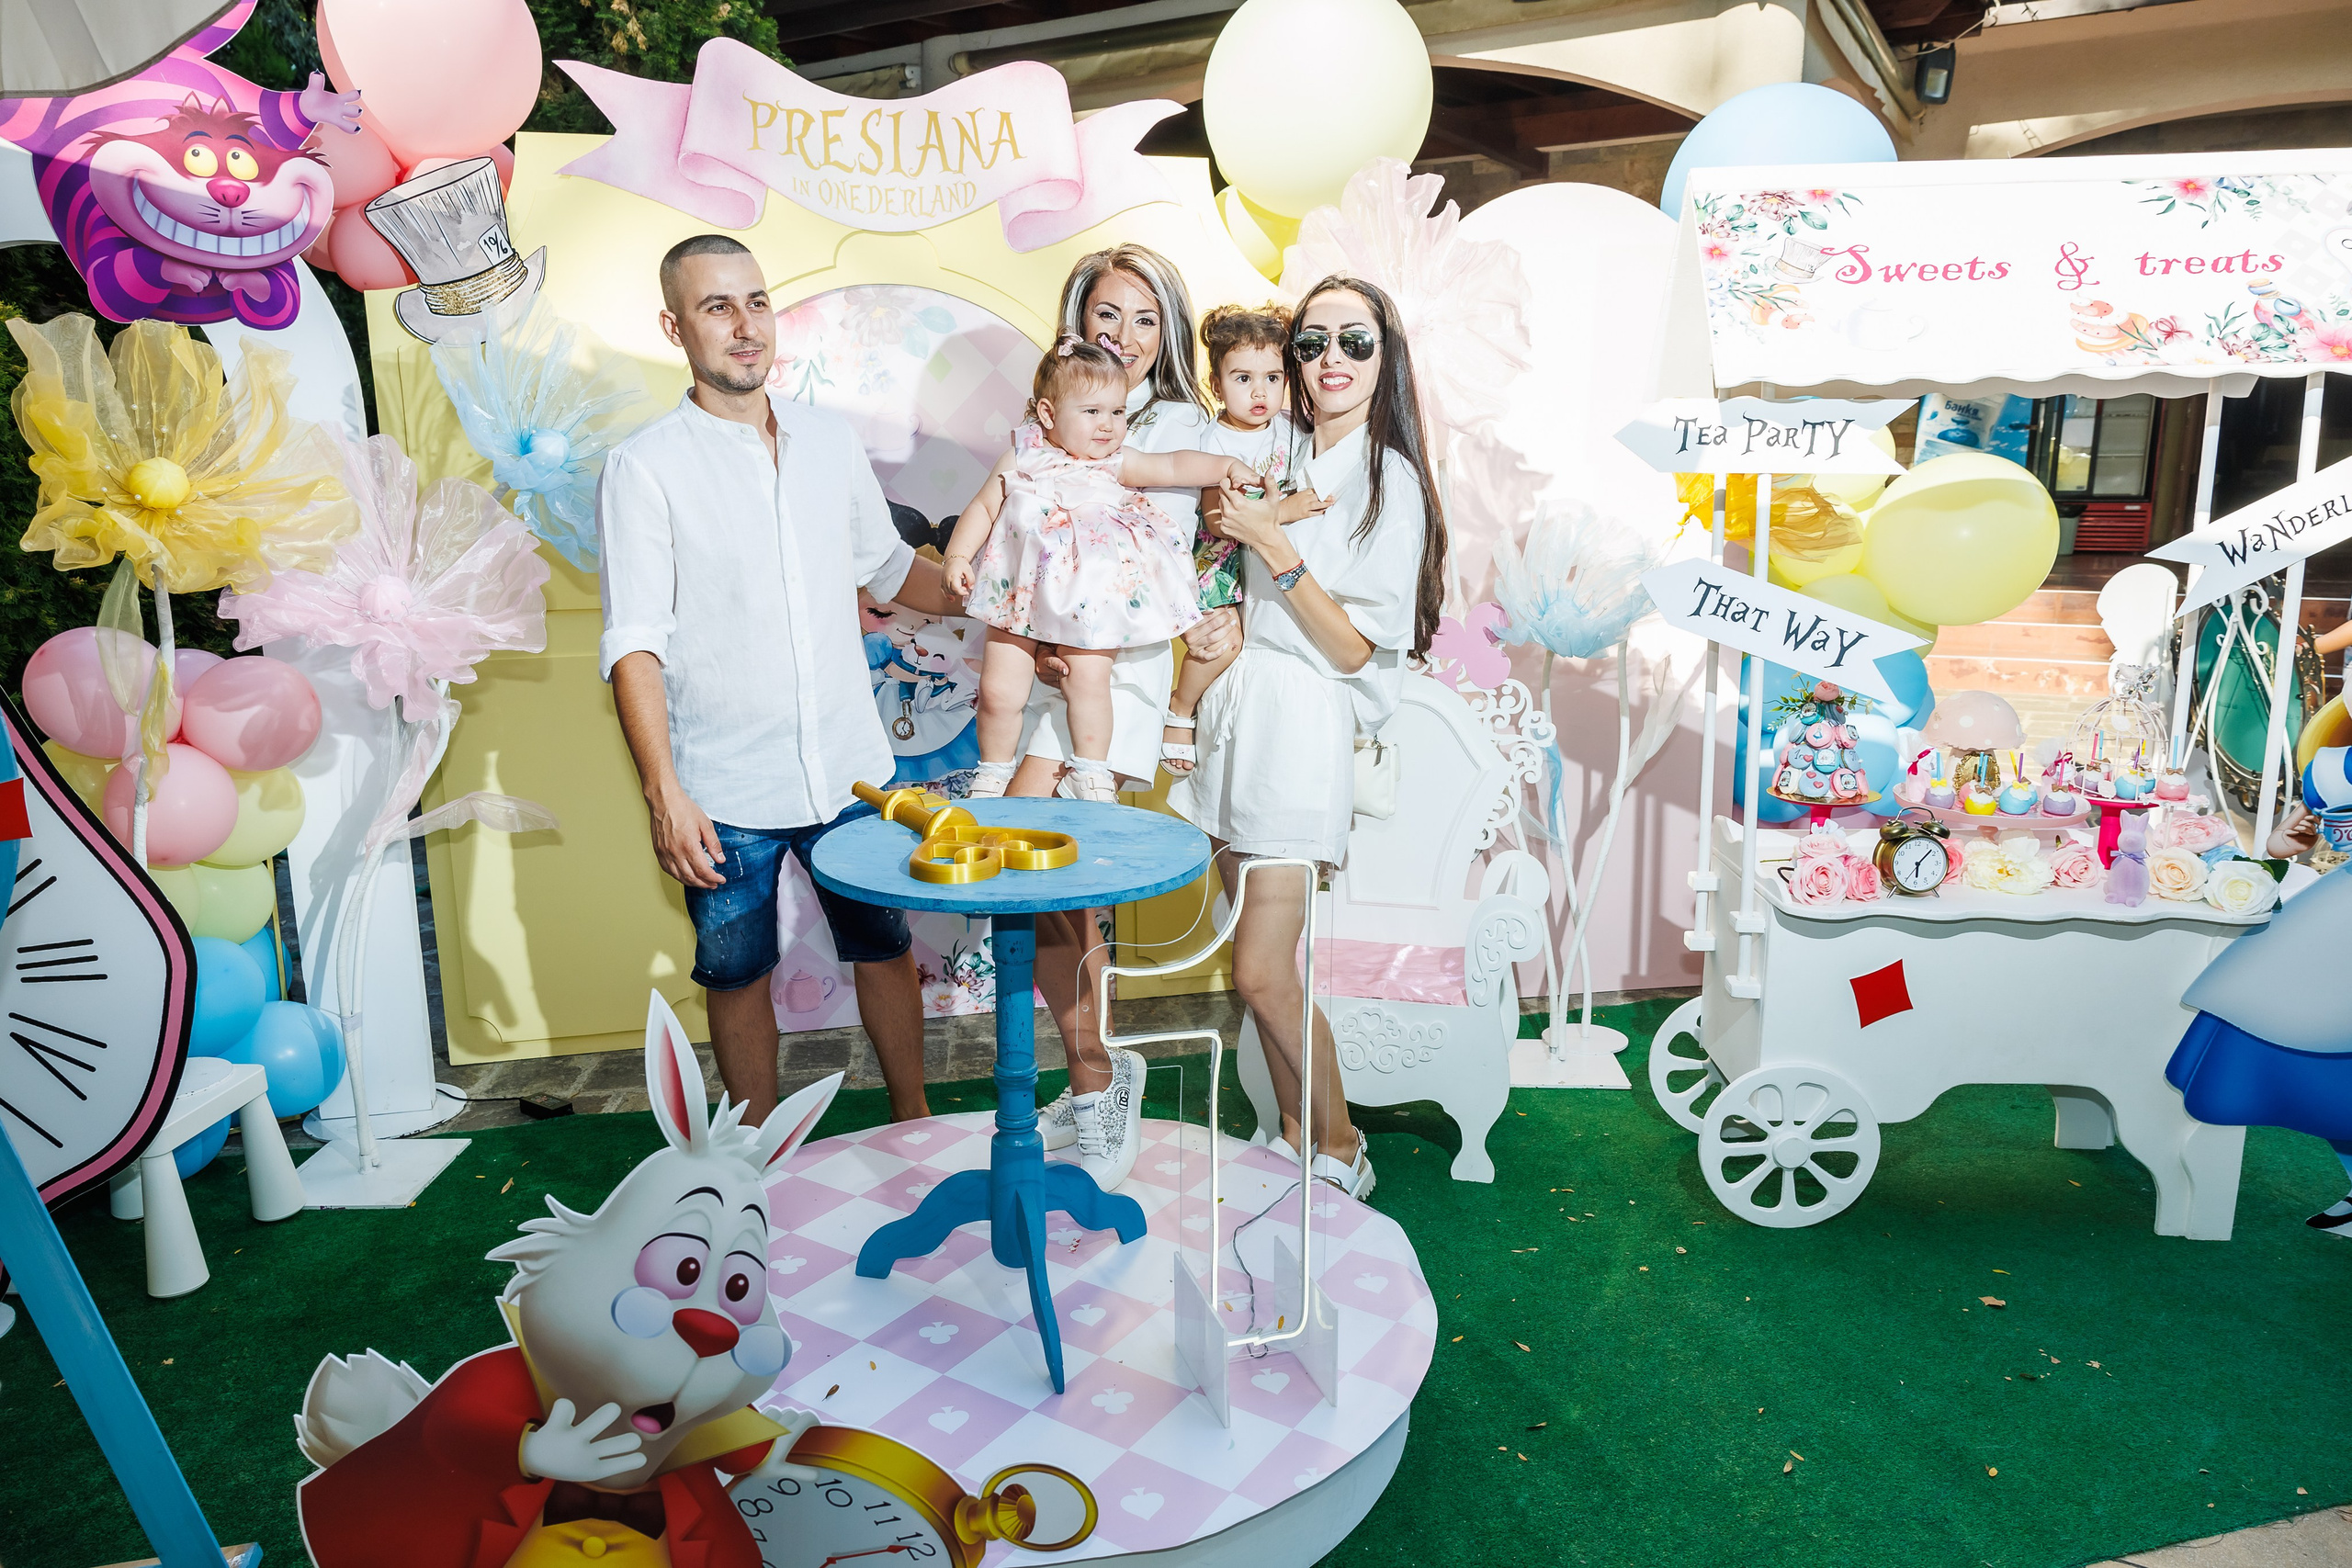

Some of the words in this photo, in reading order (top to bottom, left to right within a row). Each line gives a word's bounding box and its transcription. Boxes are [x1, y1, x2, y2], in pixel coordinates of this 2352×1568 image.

[742, 89, 1027, 179] PRESIANA
[792, 176, 810, 197] IN
[819, 179, 977, 218] ONEDERLAND
[1820, 244, 2011, 284] Sweets
[2054, 242, 2100, 291] &
[2135, 249, 2286, 276] treats
[767, 1478, 801, 1495] 9
[815, 1478, 853, 1507] 10
[738, 1498, 774, 1517] 8
[864, 1501, 901, 1526] 11
[896, 1531, 936, 1562] 12
